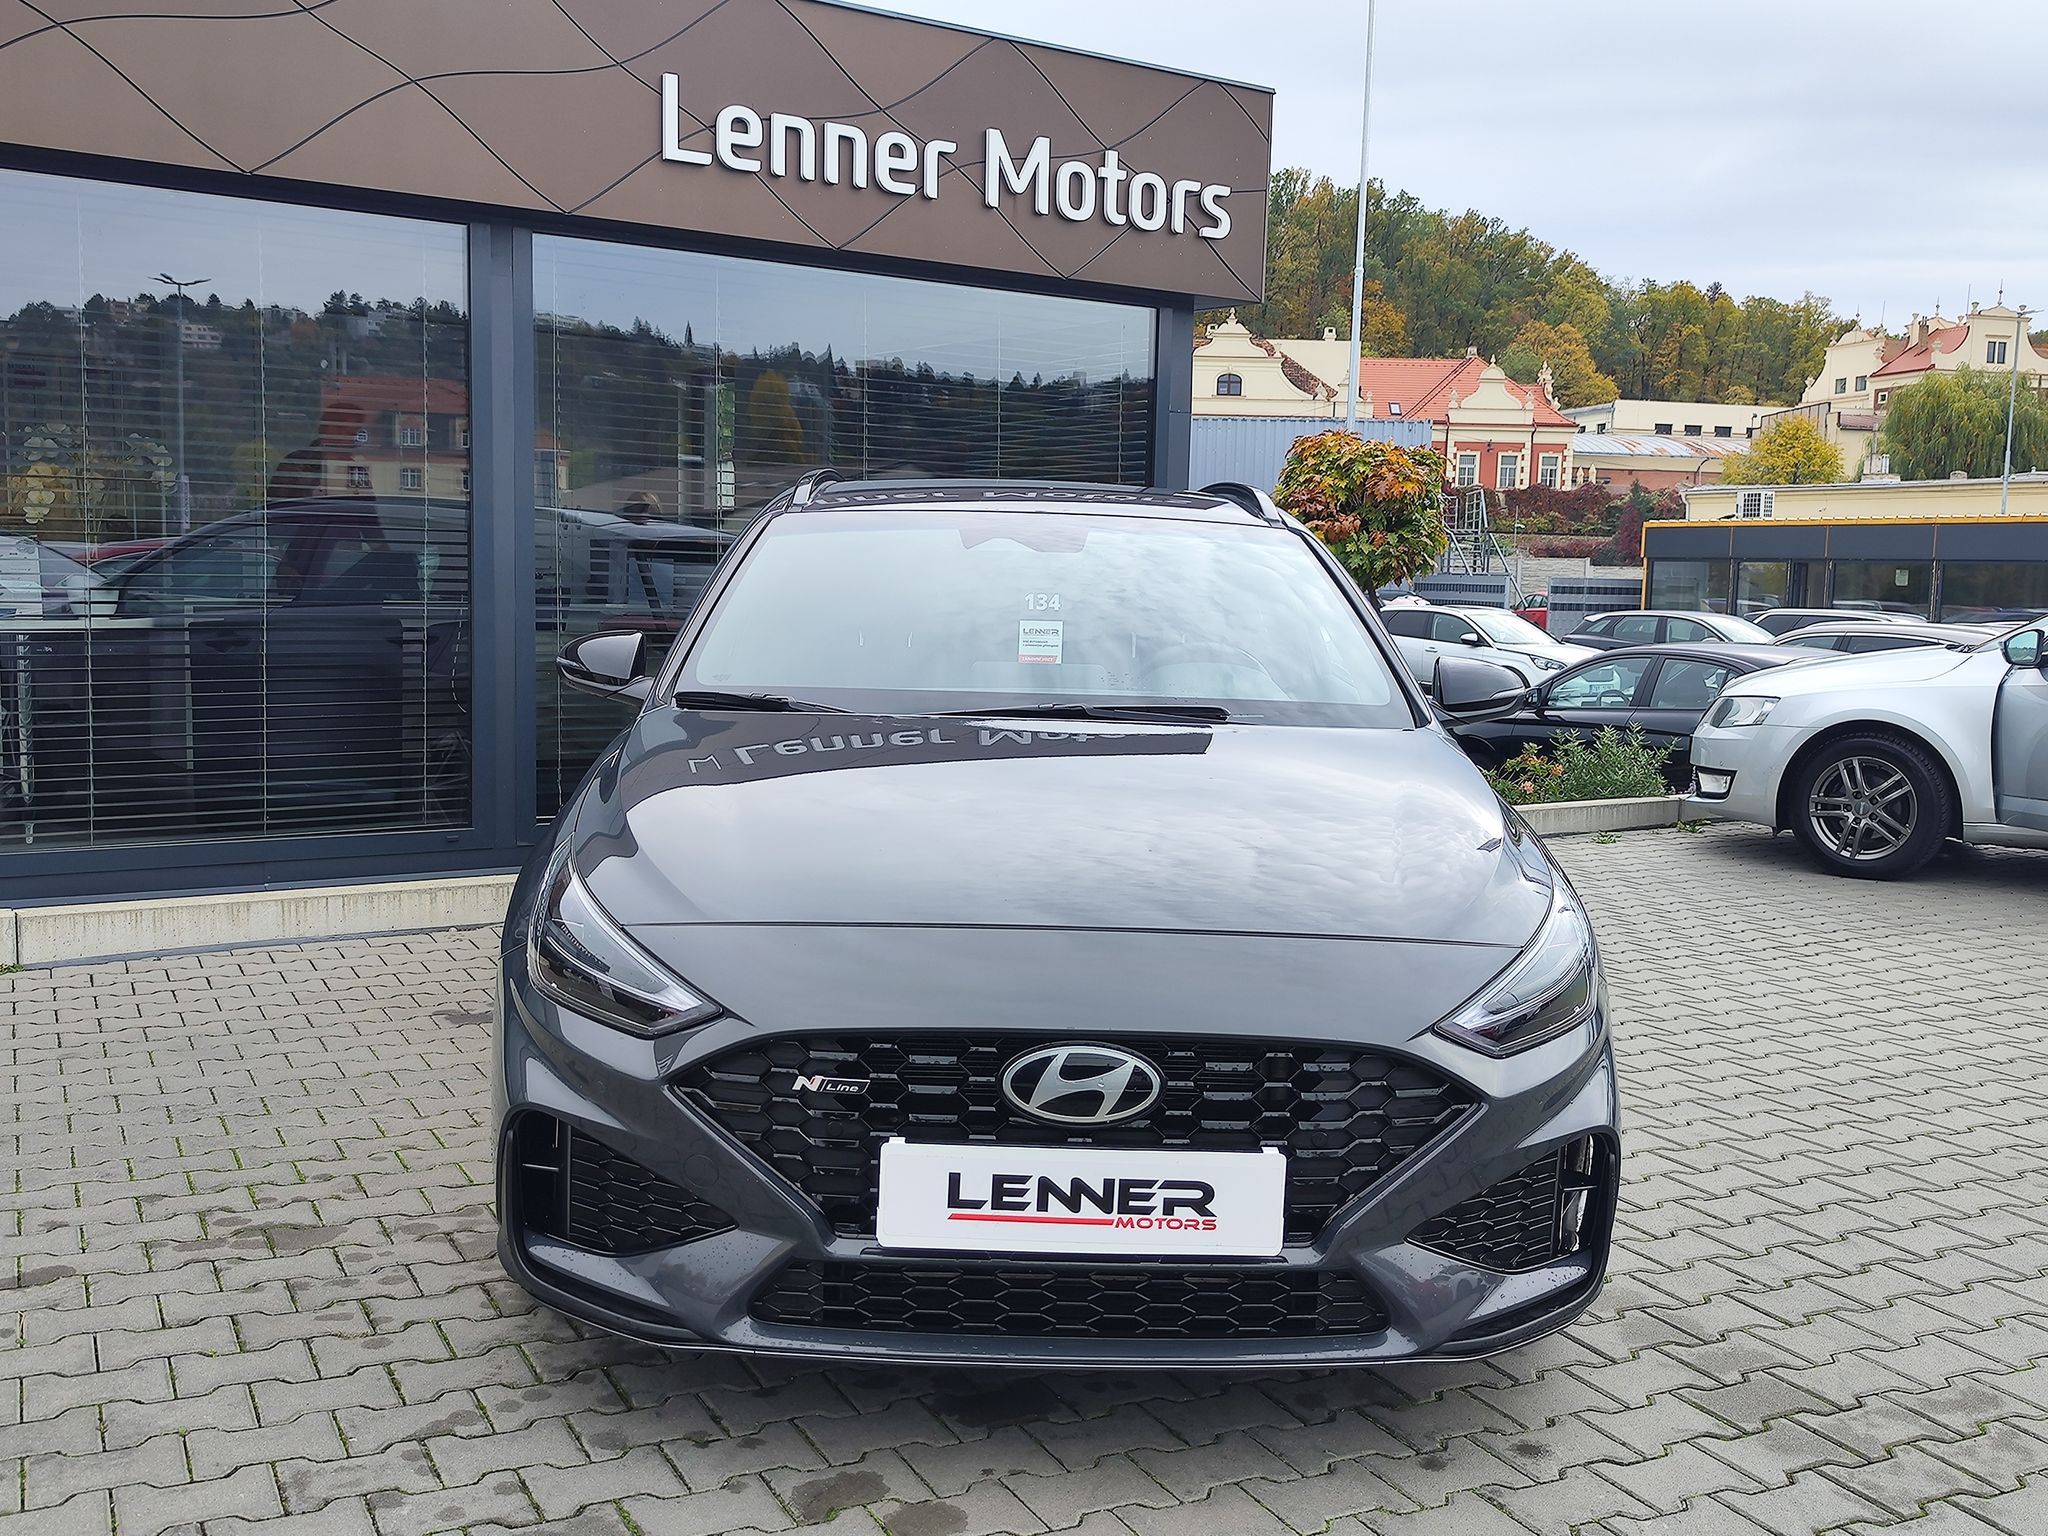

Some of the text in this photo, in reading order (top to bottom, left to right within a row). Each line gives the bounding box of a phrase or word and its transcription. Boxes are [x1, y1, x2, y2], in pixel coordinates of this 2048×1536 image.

[661, 72, 1232, 240] Lenner Motors
[1025, 593, 1062, 611] 134
[1023, 628, 1060, 637] LENNER
[792, 1075, 859, 1092] N Line
[947, 1172, 1217, 1218] LENNER
[1114, 1217, 1217, 1231] MOTORS
